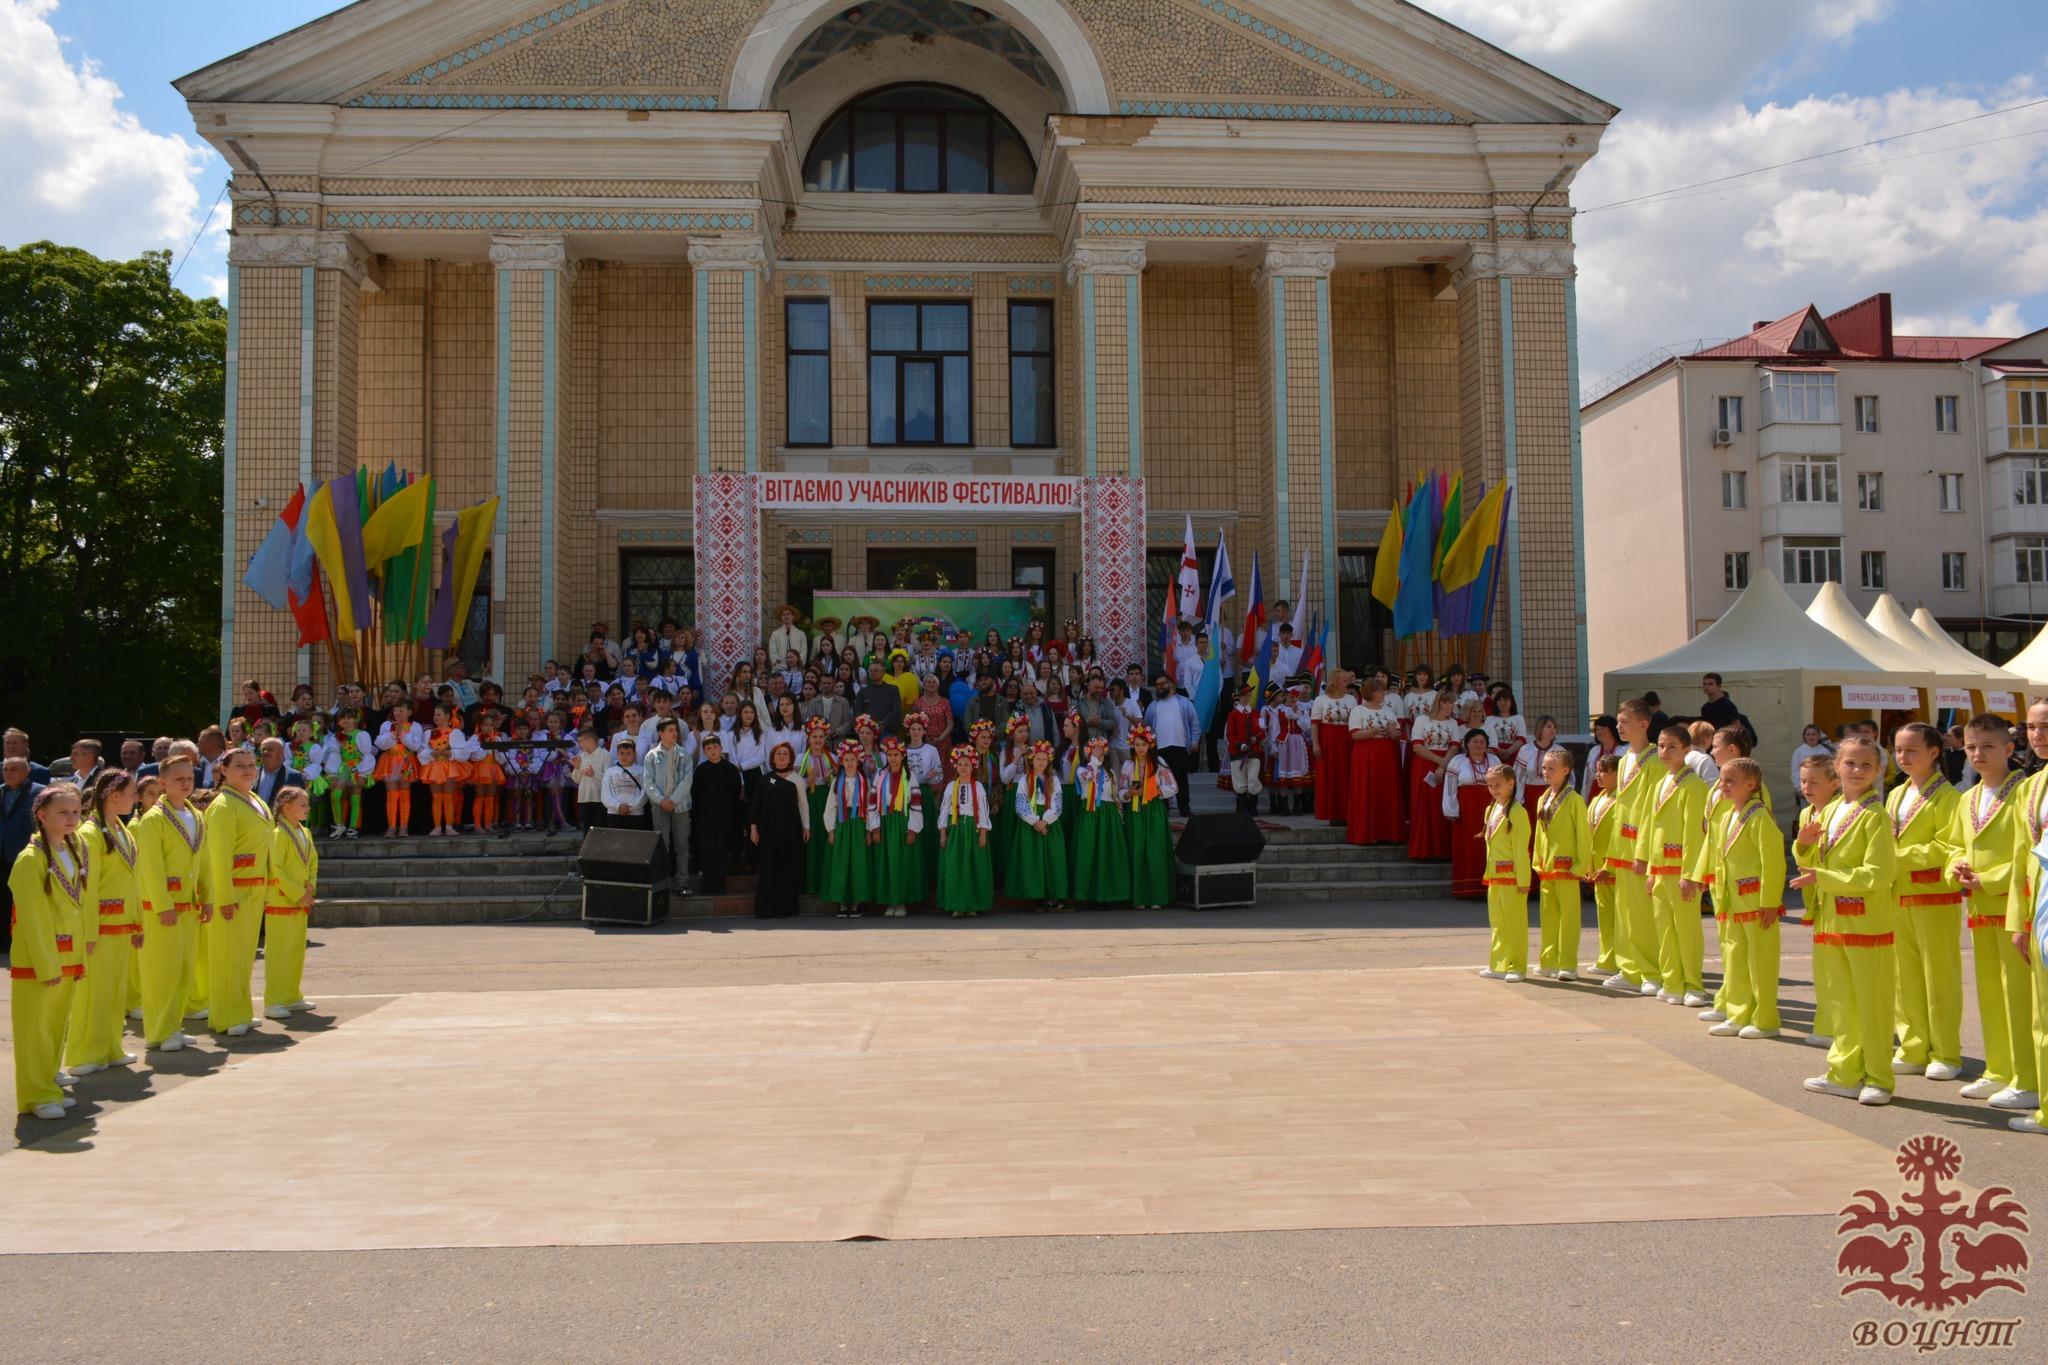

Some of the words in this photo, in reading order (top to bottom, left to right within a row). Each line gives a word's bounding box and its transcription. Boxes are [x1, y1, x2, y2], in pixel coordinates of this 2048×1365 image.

[765, 479, 843, 502] ВІТАЄМО
[848, 480, 948, 503] УЧАСНИКІВ
[952, 481, 1072, 505] ФЕСТИВАЛЮ!
